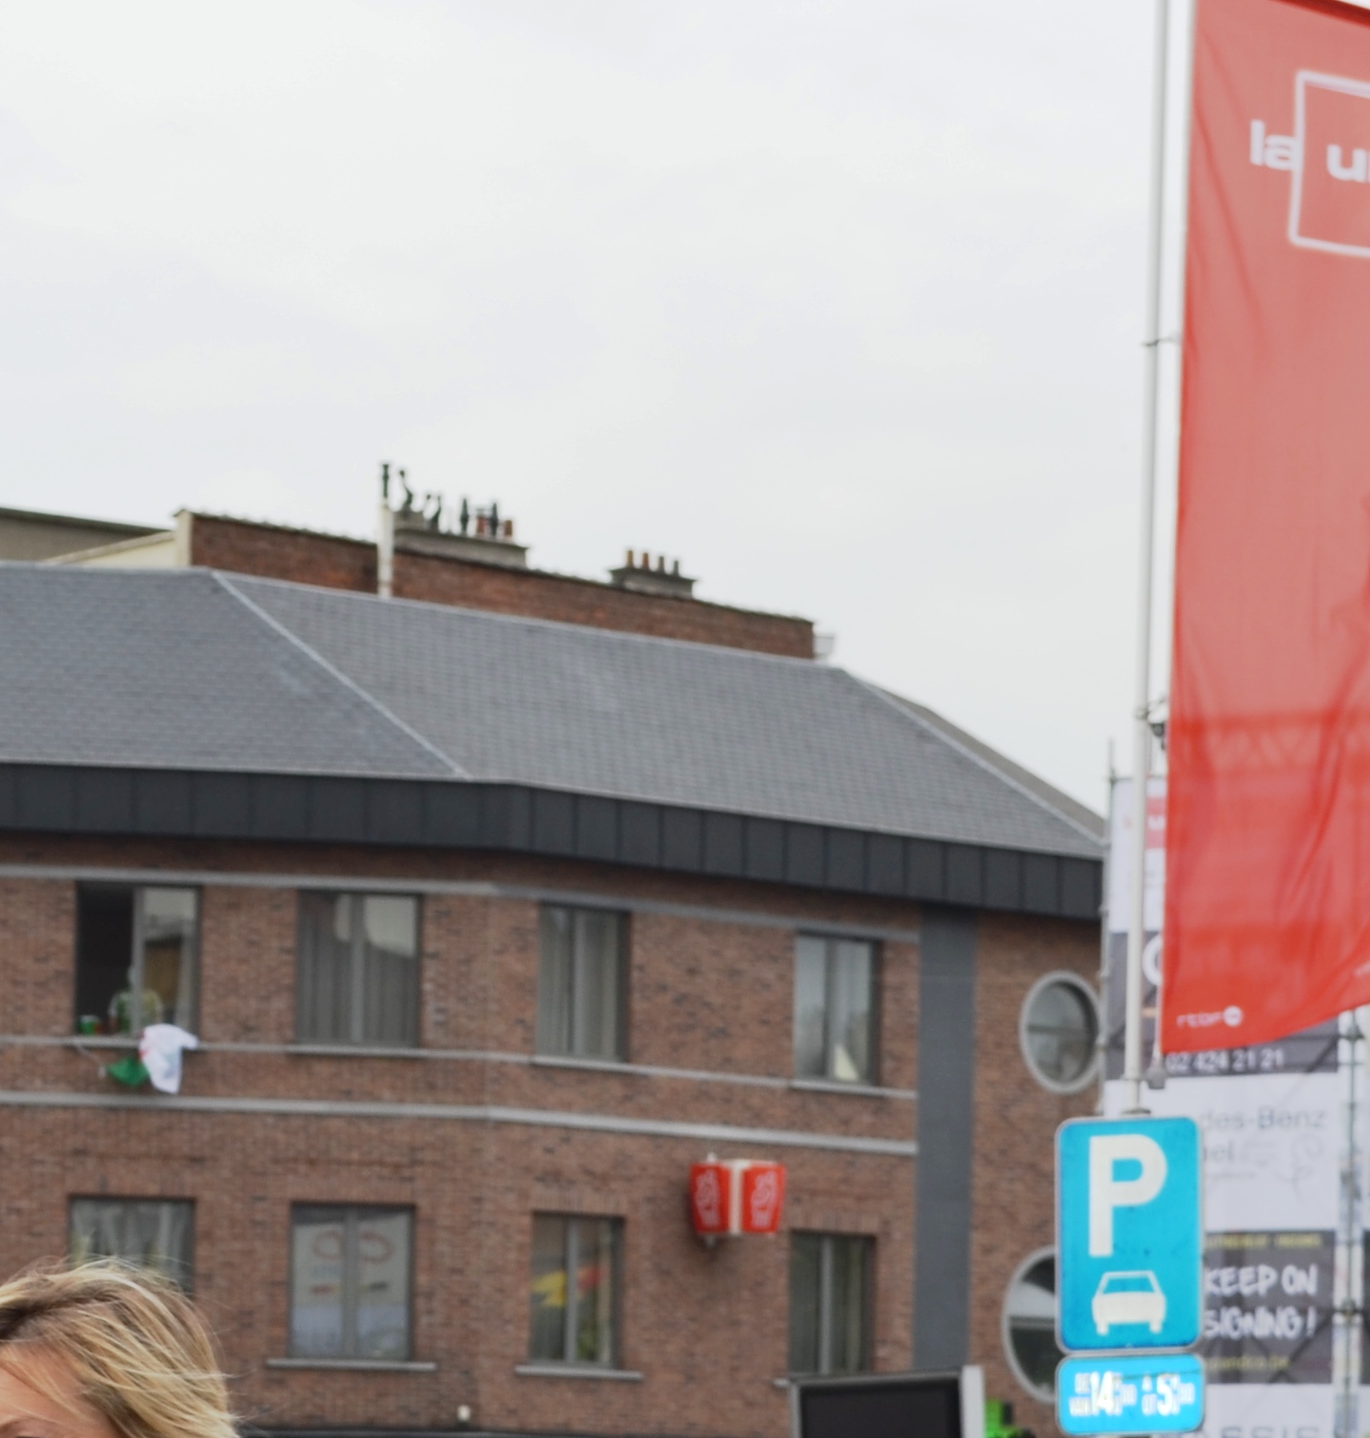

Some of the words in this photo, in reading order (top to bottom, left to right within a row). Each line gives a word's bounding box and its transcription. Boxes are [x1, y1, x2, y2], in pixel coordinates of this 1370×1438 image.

[1250, 119, 1299, 170] la
[1193, 1052, 1229, 1073] 424
[1231, 1048, 1256, 1073] 21
[1259, 1047, 1284, 1071] 21
[1088, 1134, 1168, 1258] P
[1204, 1264, 1279, 1296] KEEP
[1281, 1263, 1319, 1296] ON
